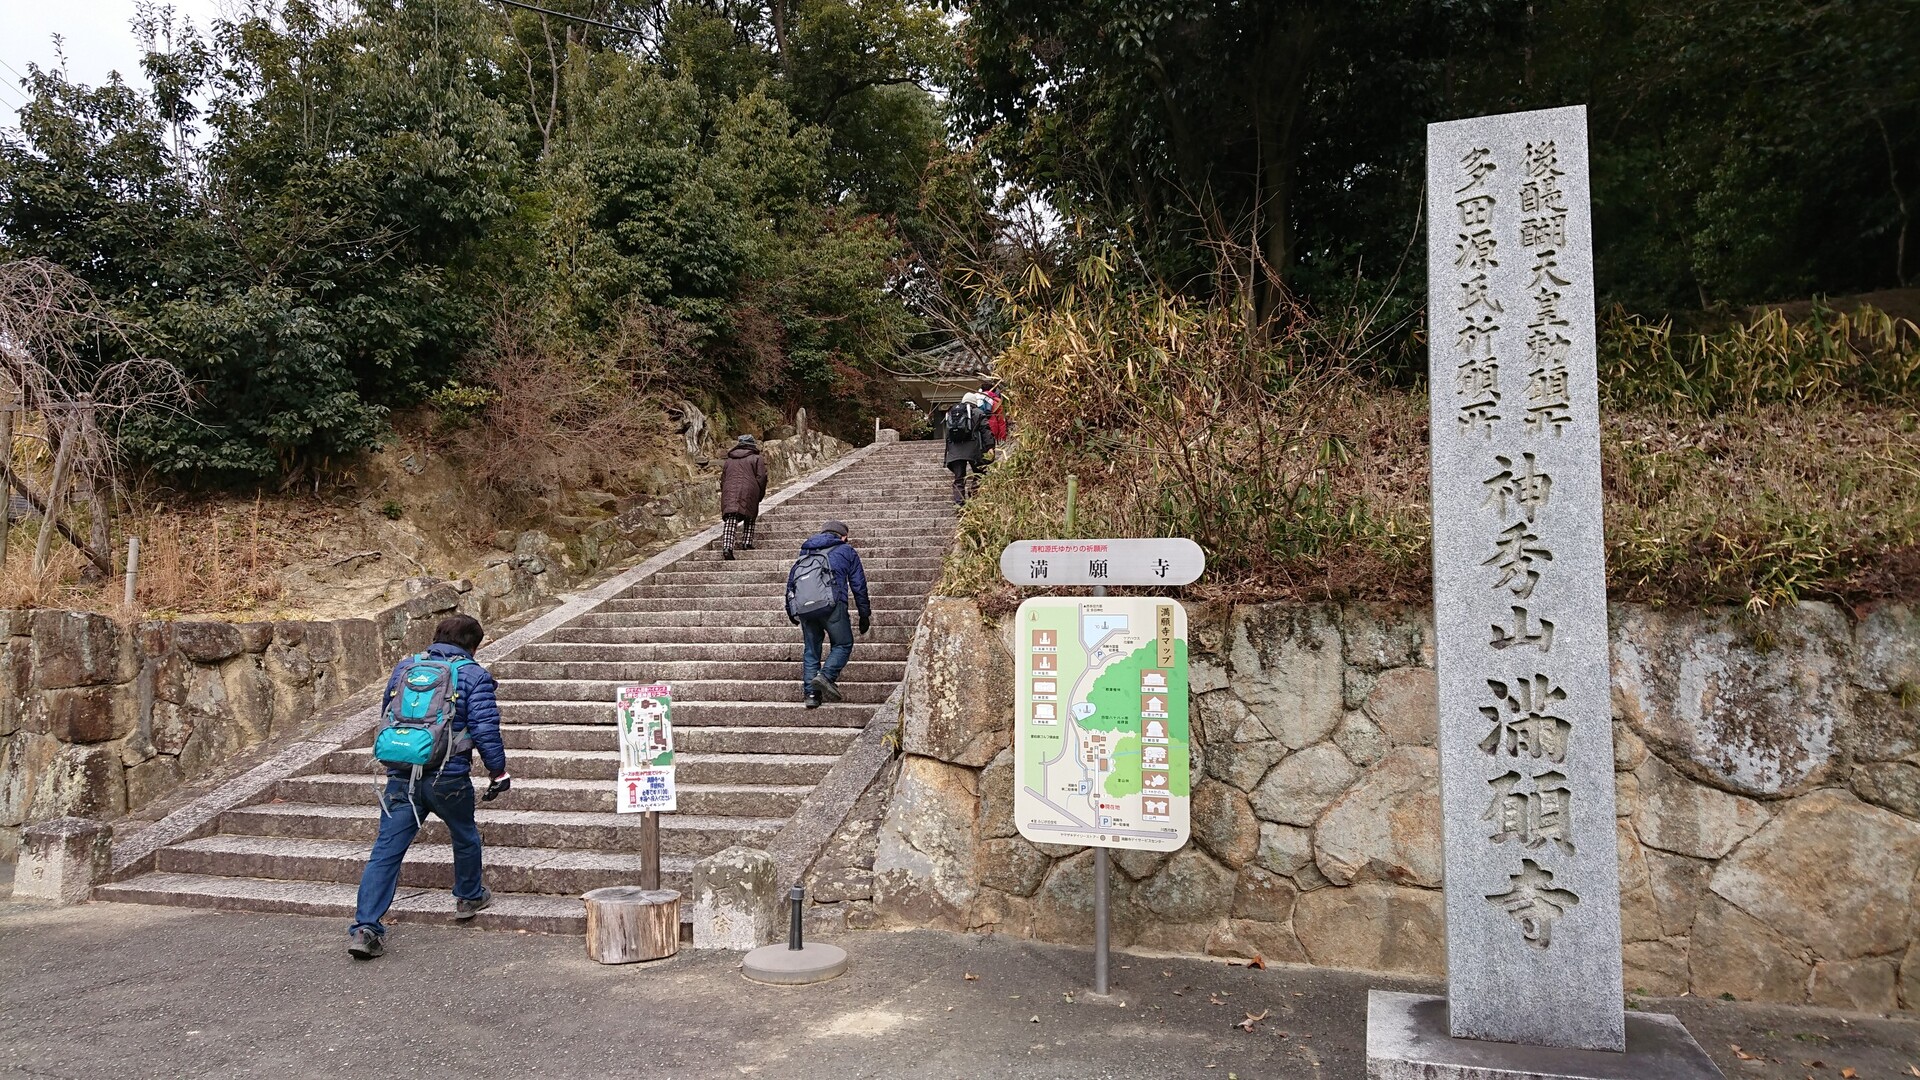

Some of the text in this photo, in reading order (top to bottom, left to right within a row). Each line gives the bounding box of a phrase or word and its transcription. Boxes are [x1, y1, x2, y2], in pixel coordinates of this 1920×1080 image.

[1454, 146, 1504, 442] 多田源氏祈願所
[1030, 544, 1108, 553] 清和源氏ゆかりの祈願所
[1030, 558, 1170, 579] 満願寺
[1160, 607, 1172, 665] 満願寺マップ
[1080, 784, 1087, 792] P
[1104, 803, 1121, 811] 現在地
